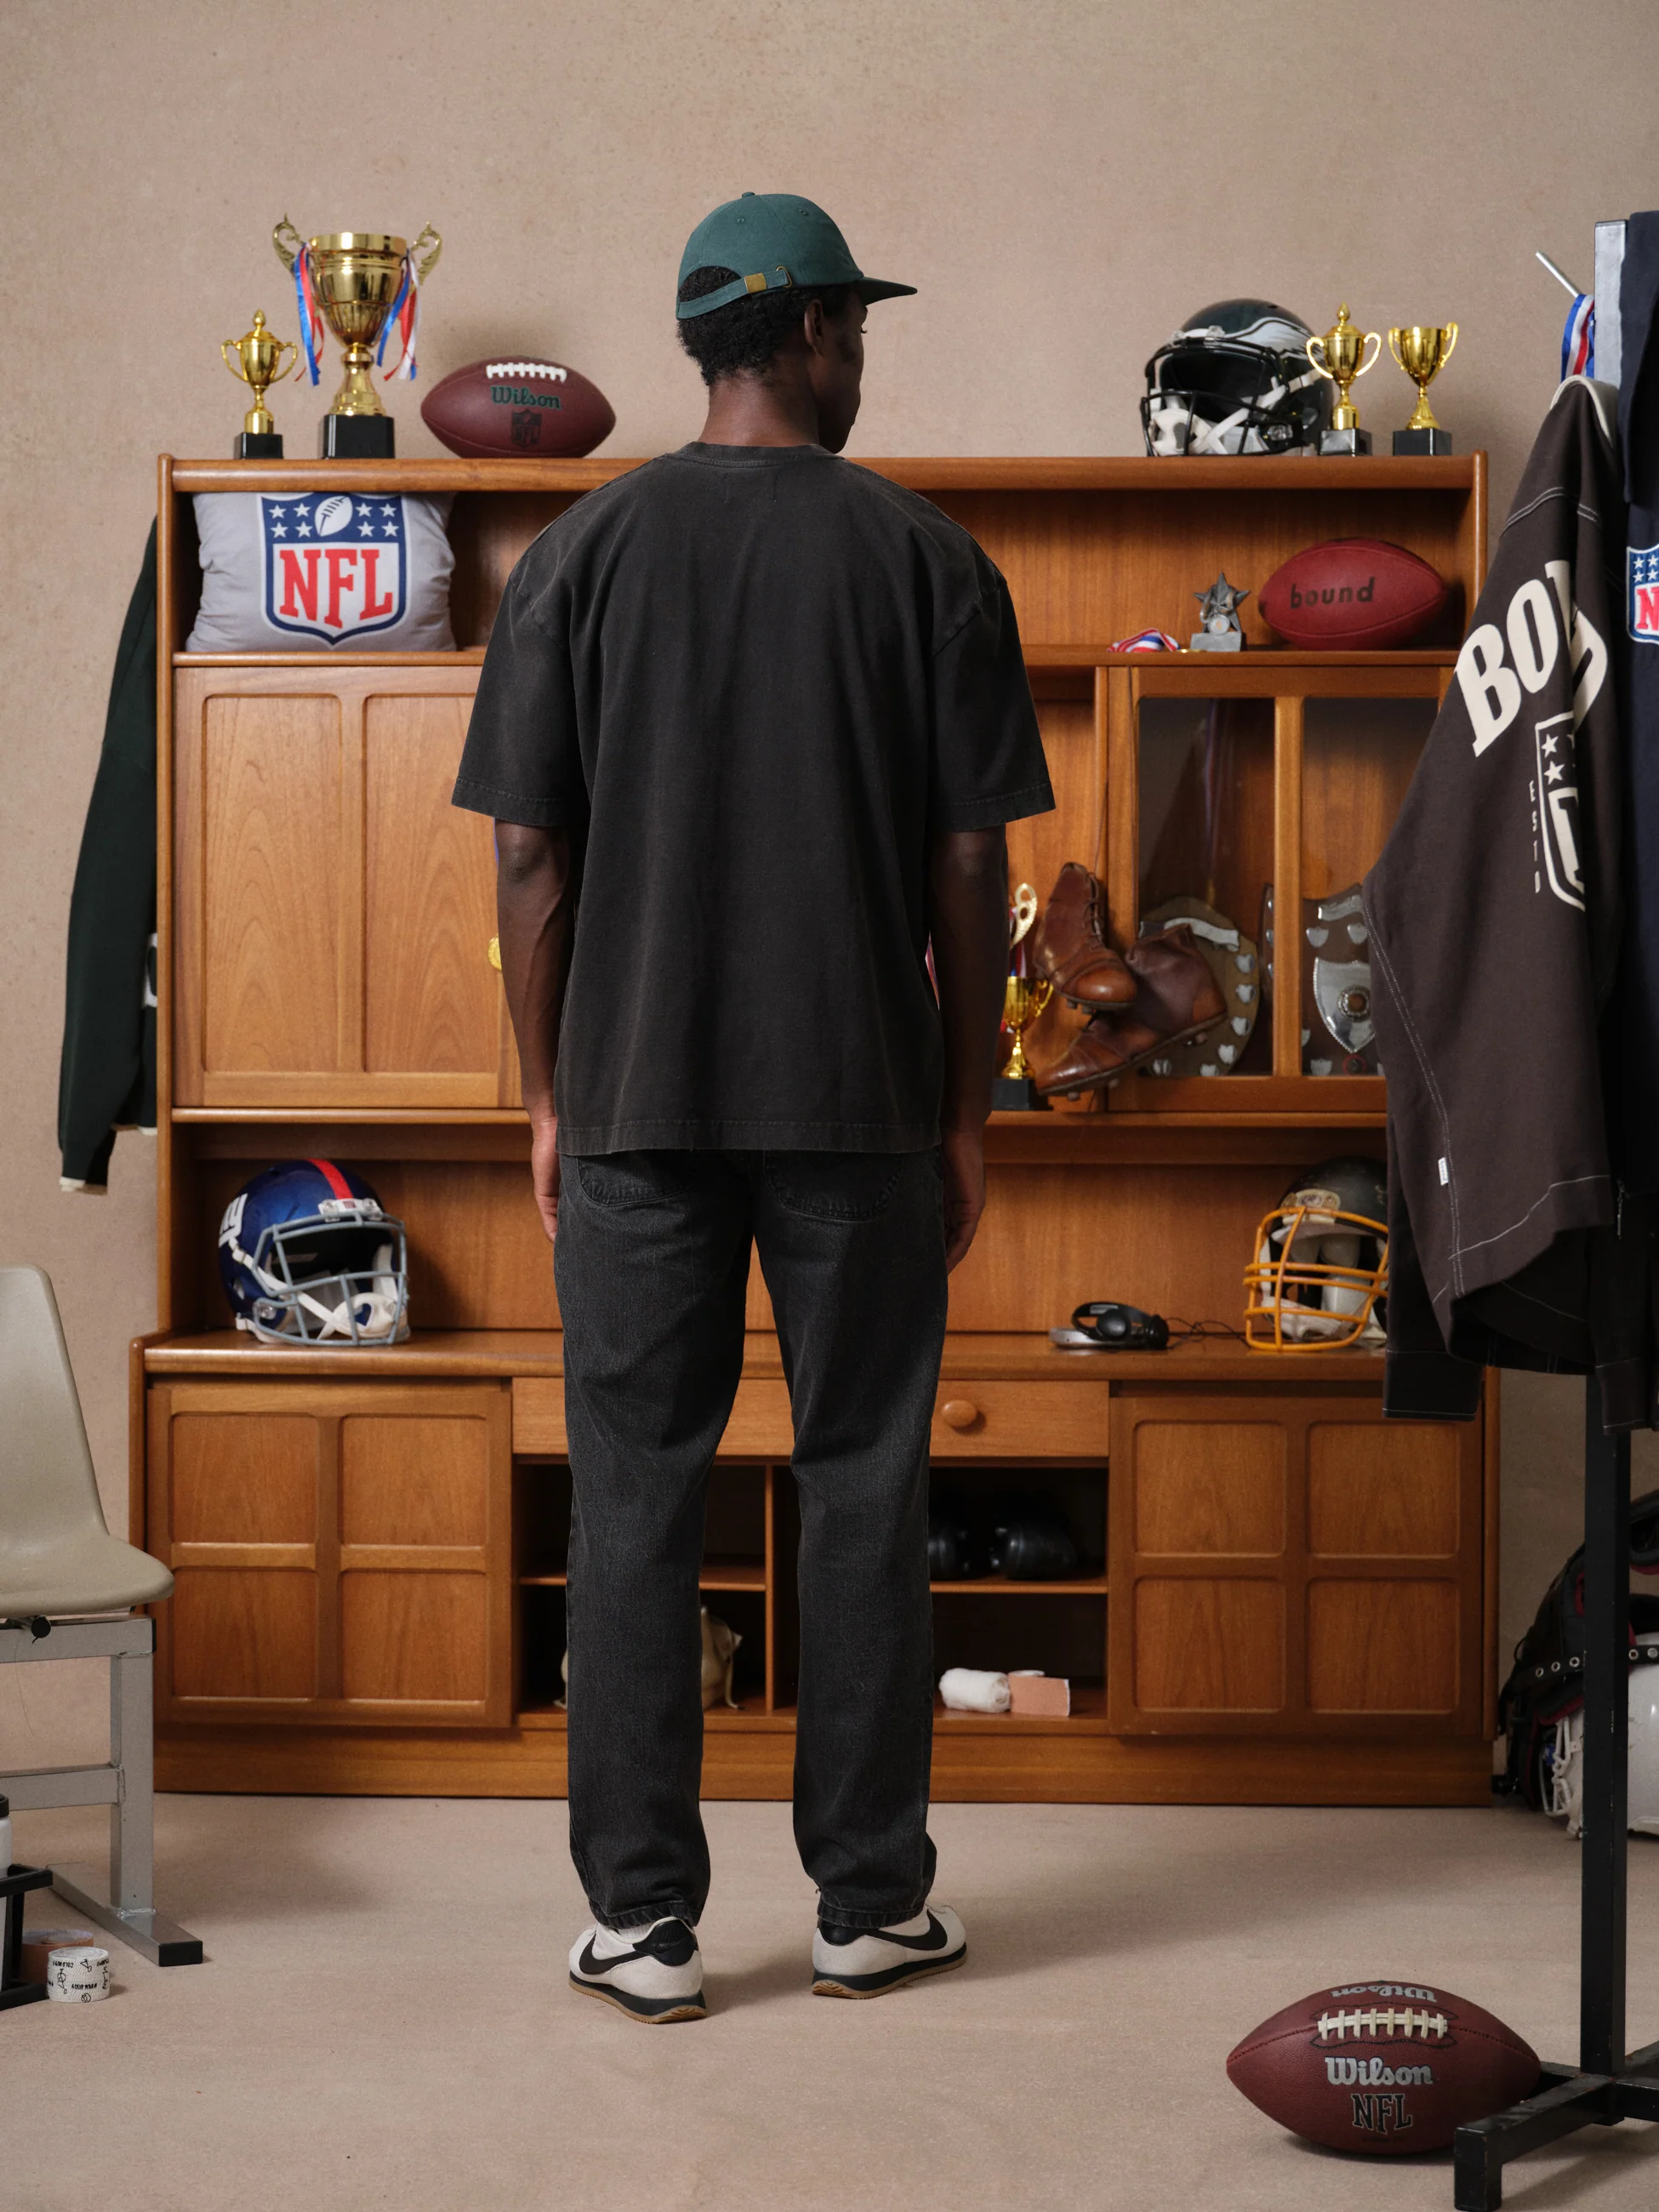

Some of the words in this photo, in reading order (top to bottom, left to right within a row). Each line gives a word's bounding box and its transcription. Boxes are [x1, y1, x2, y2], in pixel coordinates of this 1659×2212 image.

[490, 385, 561, 409] Wilson
[279, 549, 393, 629] NFL
[1290, 576, 1375, 609] bound
[1325, 2056, 1433, 2085] Wilson
[1351, 2093, 1413, 2134] NFL
